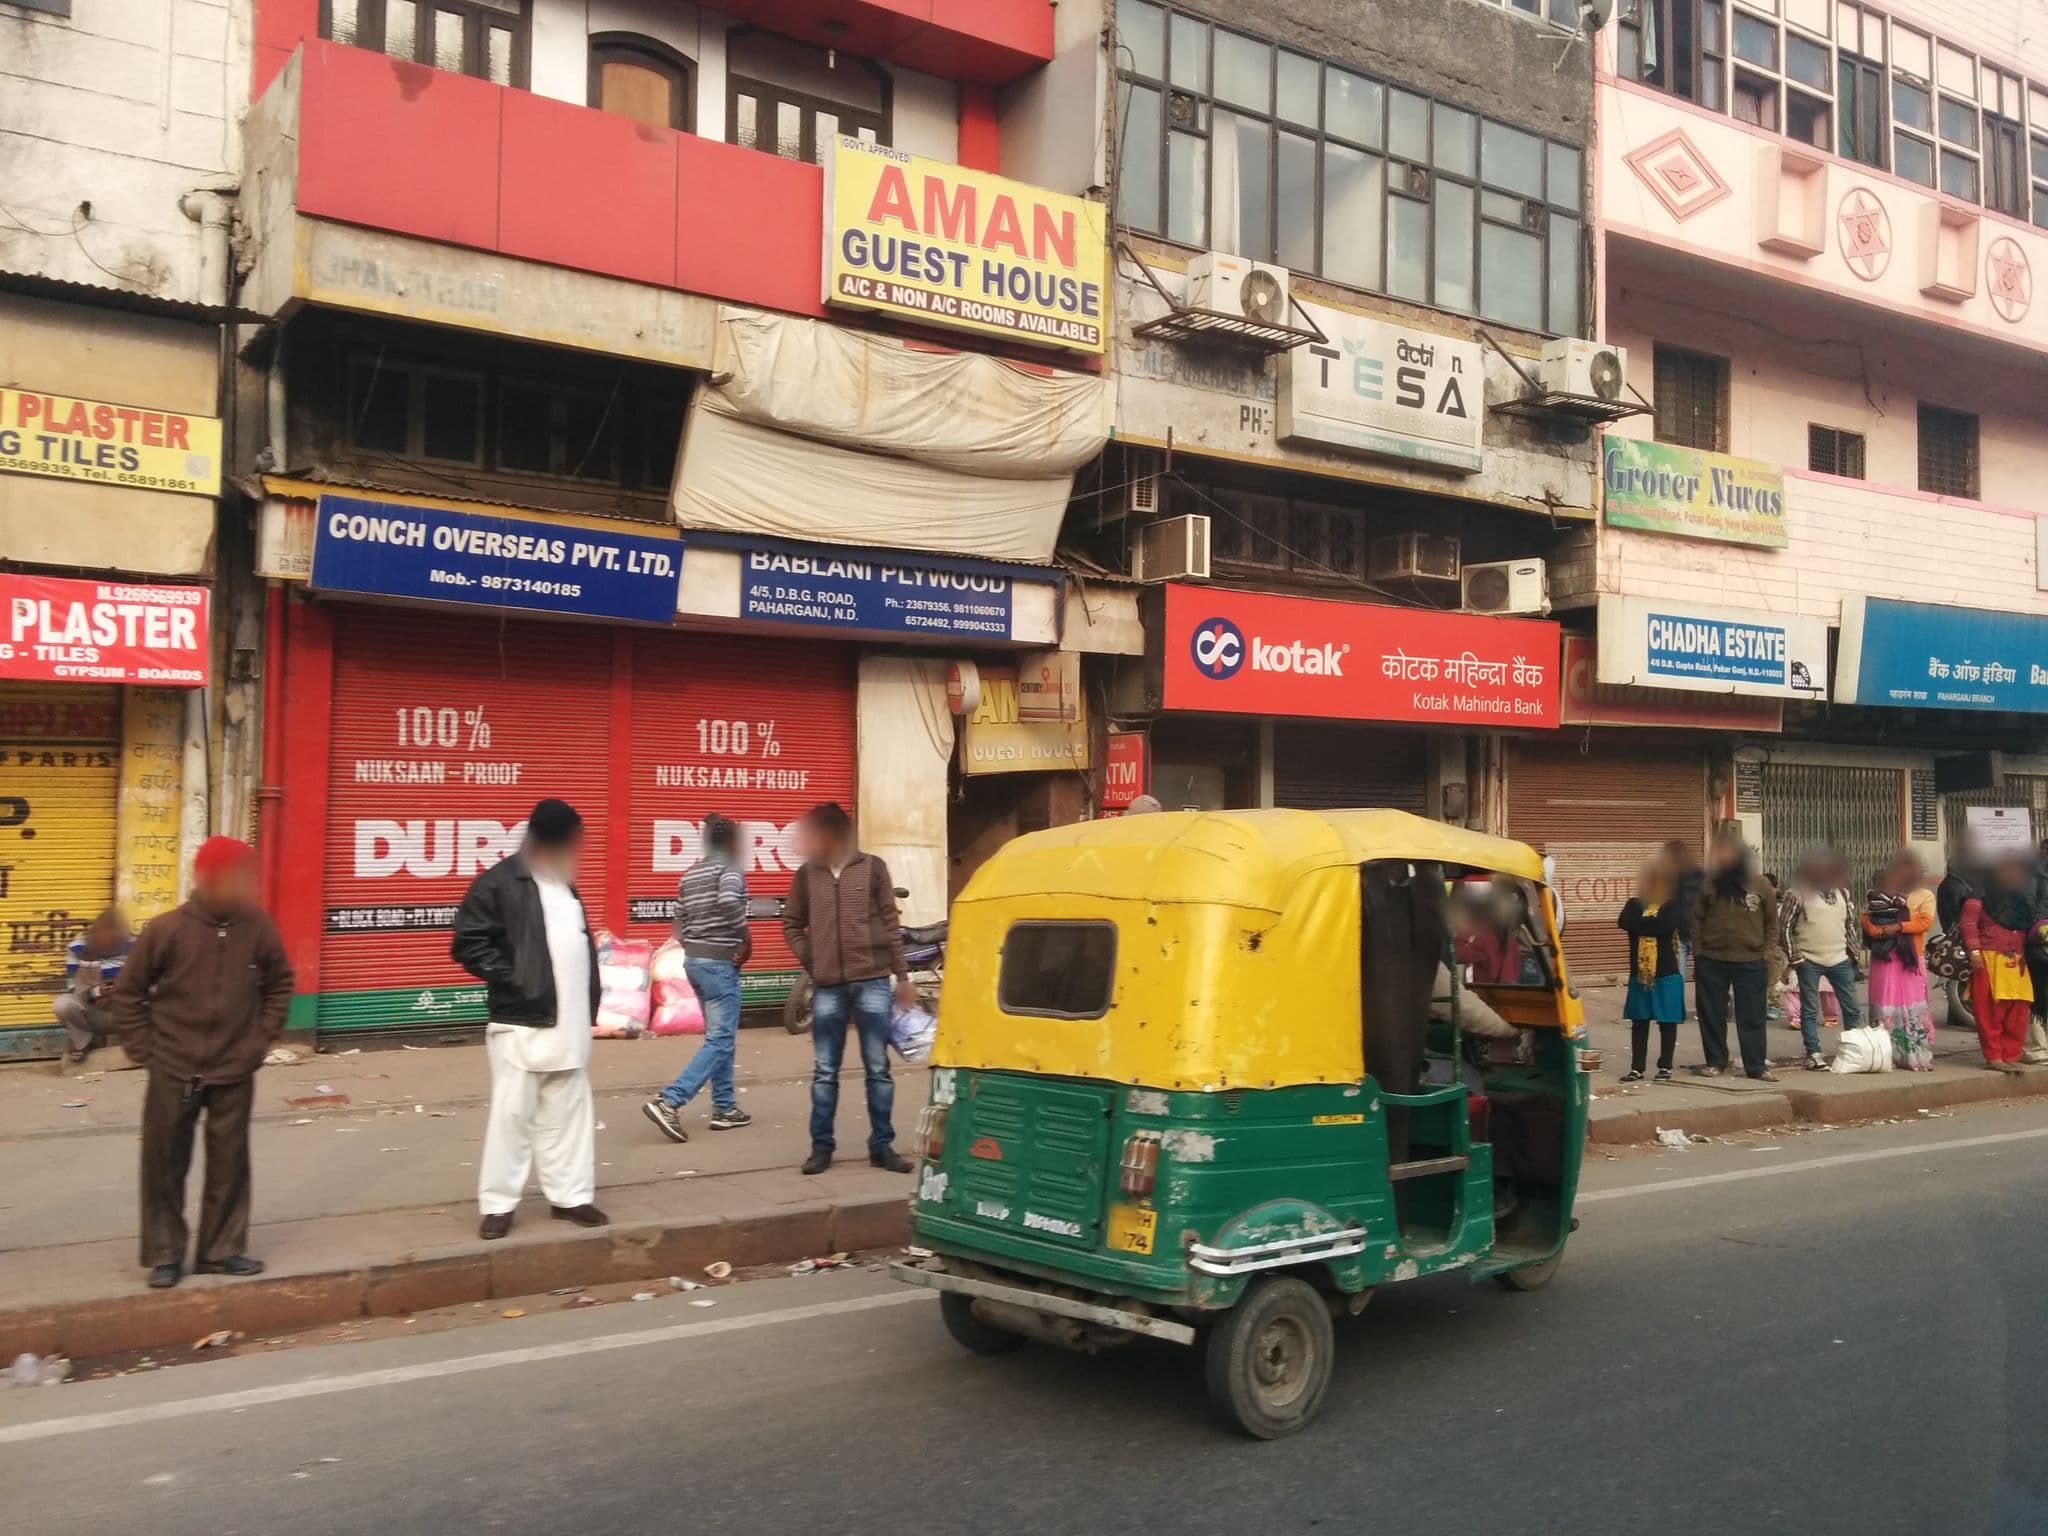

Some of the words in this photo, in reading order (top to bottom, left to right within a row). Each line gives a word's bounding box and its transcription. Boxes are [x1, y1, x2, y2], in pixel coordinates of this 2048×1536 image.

[867, 164, 1077, 269] AMAN
[842, 228, 970, 289] GUEST
[982, 258, 1100, 318] HOUSE
[843, 276, 870, 297] A/C
[875, 283, 888, 300] &
[892, 287, 927, 309] NON
[931, 294, 957, 315] A/C
[961, 300, 1015, 327] ROOMS
[1018, 313, 1097, 343] AVAILABLE
[1309, 343, 1467, 419] TESA
[17, 393, 190, 451] PLASTER
[36, 434, 140, 472] TILES
[82, 468, 112, 482] Tel.
[118, 474, 196, 491] 65891861
[1605, 448, 1700, 503] Grover
[1708, 467, 1783, 517] Niwas
[328, 513, 426, 549] CONCH
[433, 525, 566, 565] OVERSEAS
[571, 541, 621, 572] PVT.
[627, 549, 675, 578] LTD.
[750, 552, 872, 581] BABLANI
[480, 575, 582, 598] 9873140185
[750, 585, 772, 600] 4/5,
[775, 587, 814, 602] D.B.G.
[817, 591, 857, 608] ROAD,
[11, 597, 198, 650] PLASTER
[748, 600, 831, 620] PAHARGANJ,
[834, 608, 859, 621] N.D.
[33, 645, 100, 664] TILES
[1649, 619, 1721, 657] CHADHA
[1724, 627, 1785, 662] ESTATE
[54, 665, 125, 679] GYPSUM
[137, 667, 203, 681] BOARDS
[1381, 647, 1440, 681] कोटक
[1444, 651, 1508, 688] महिन्द्रा
[1512, 655, 1544, 688] बैंक
[1675, 661, 1694, 673] Gupta
[1928, 657, 1950, 679] बैंक
[1981, 661, 2016, 685] इंडिया
[1413, 692, 1450, 711] Kotak
[1453, 694, 1511, 713] Mahindra
[1514, 698, 1544, 715] Bank
[1937, 691, 1971, 702] PAHARGANJ
[1971, 694, 1996, 704] BRANCH
